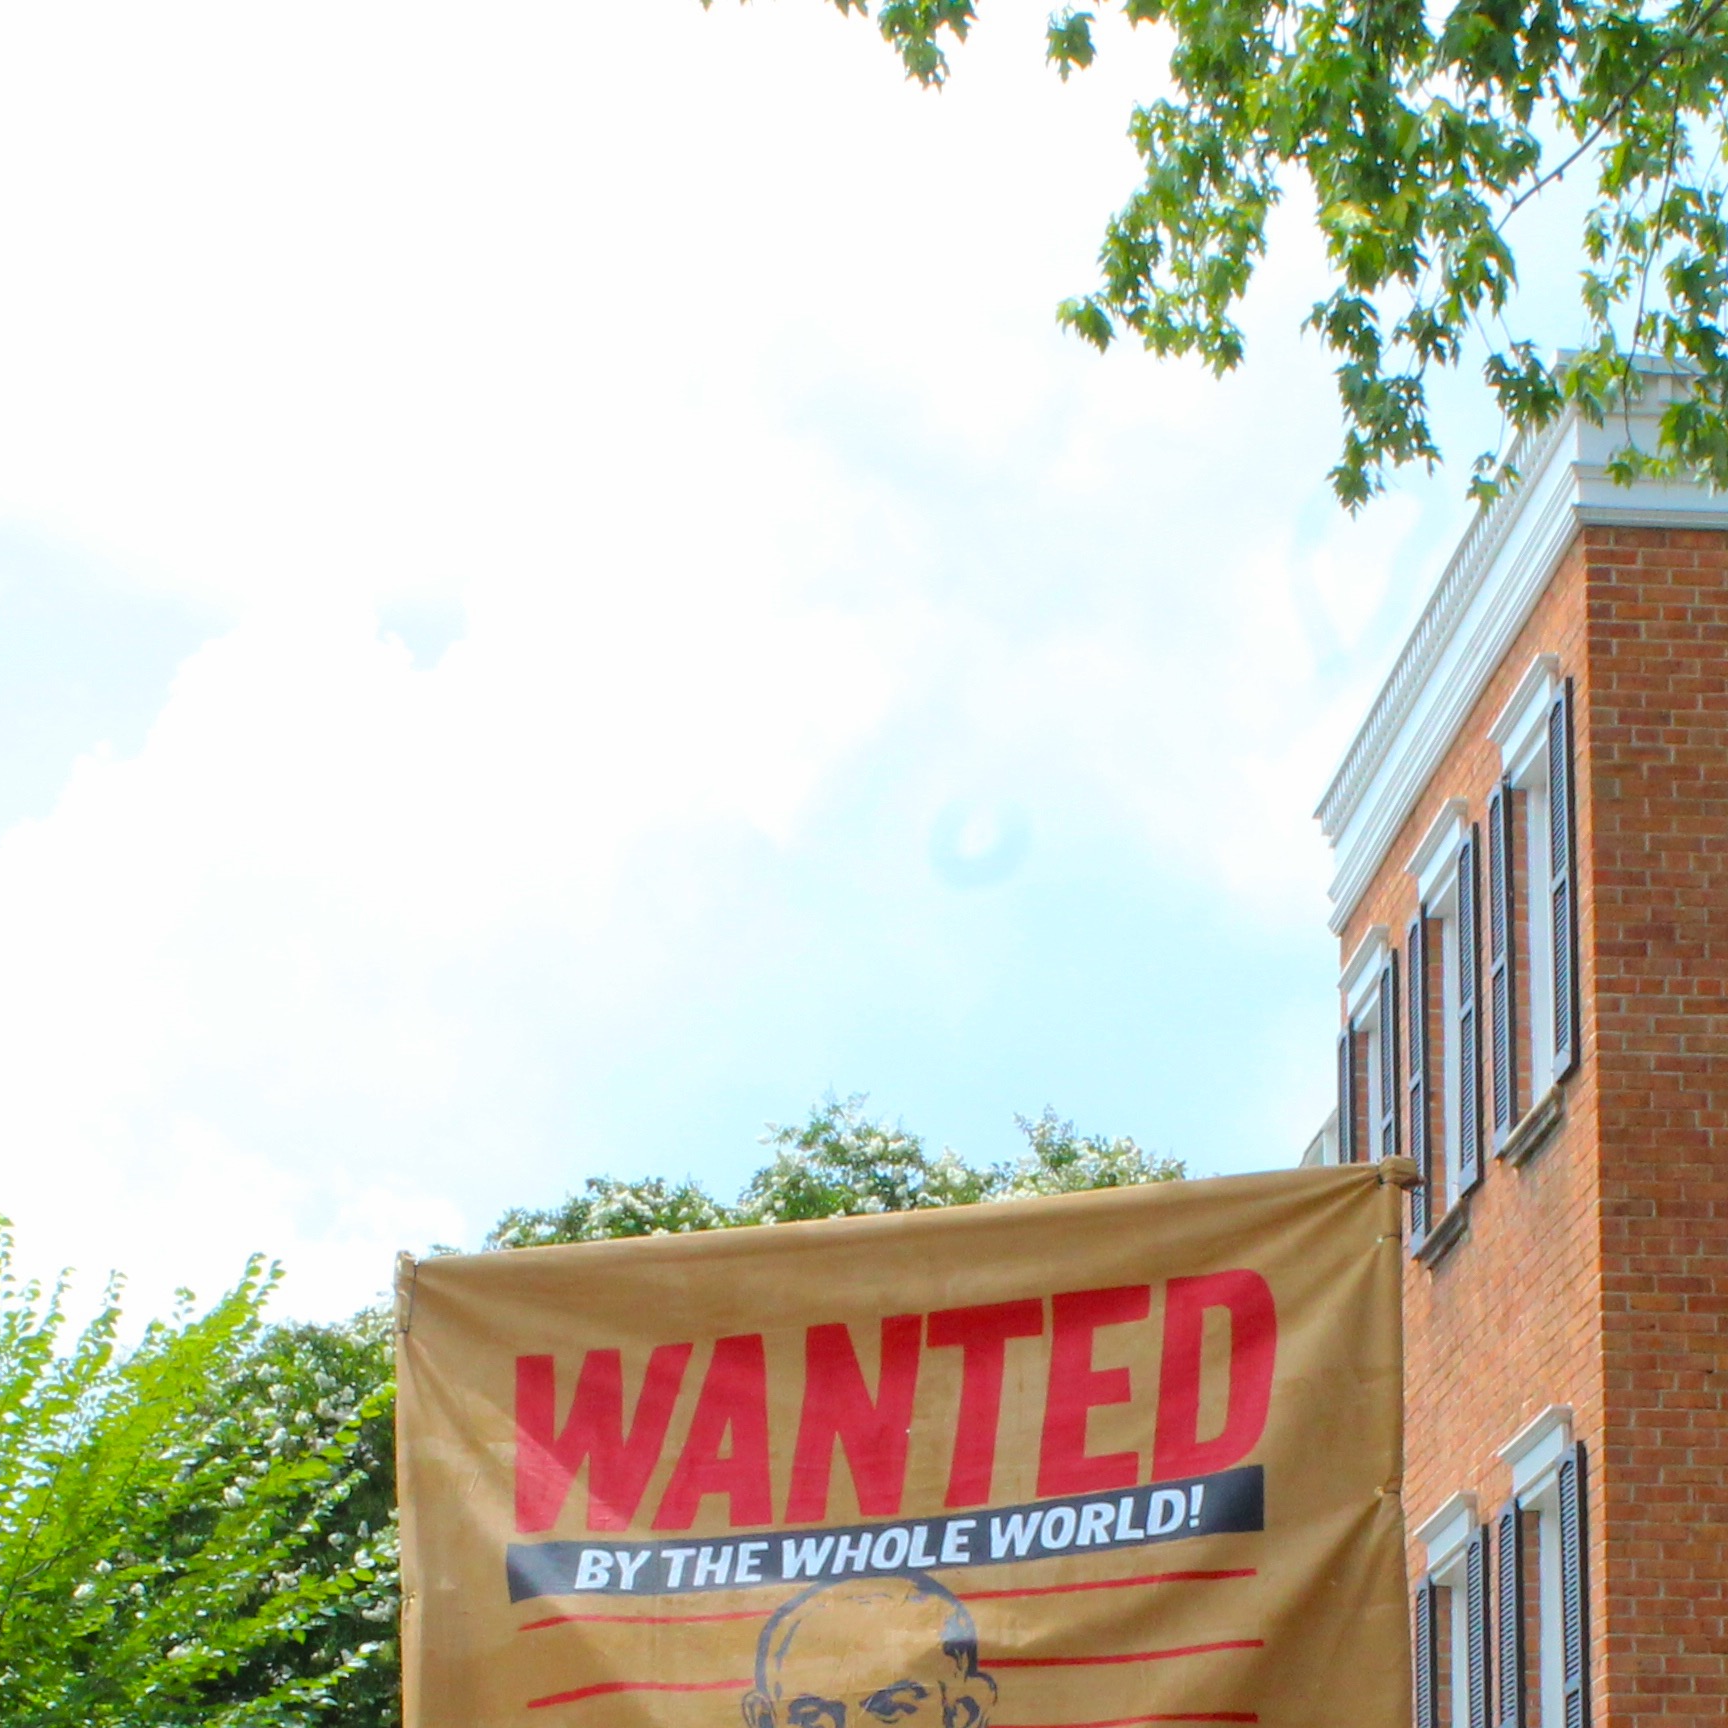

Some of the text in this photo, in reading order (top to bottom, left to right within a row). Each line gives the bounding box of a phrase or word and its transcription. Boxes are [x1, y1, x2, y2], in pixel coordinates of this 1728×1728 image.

[513, 1268, 1278, 1533] WANTED
[574, 1484, 1206, 1591] BY THE WHOLE WORLD!
